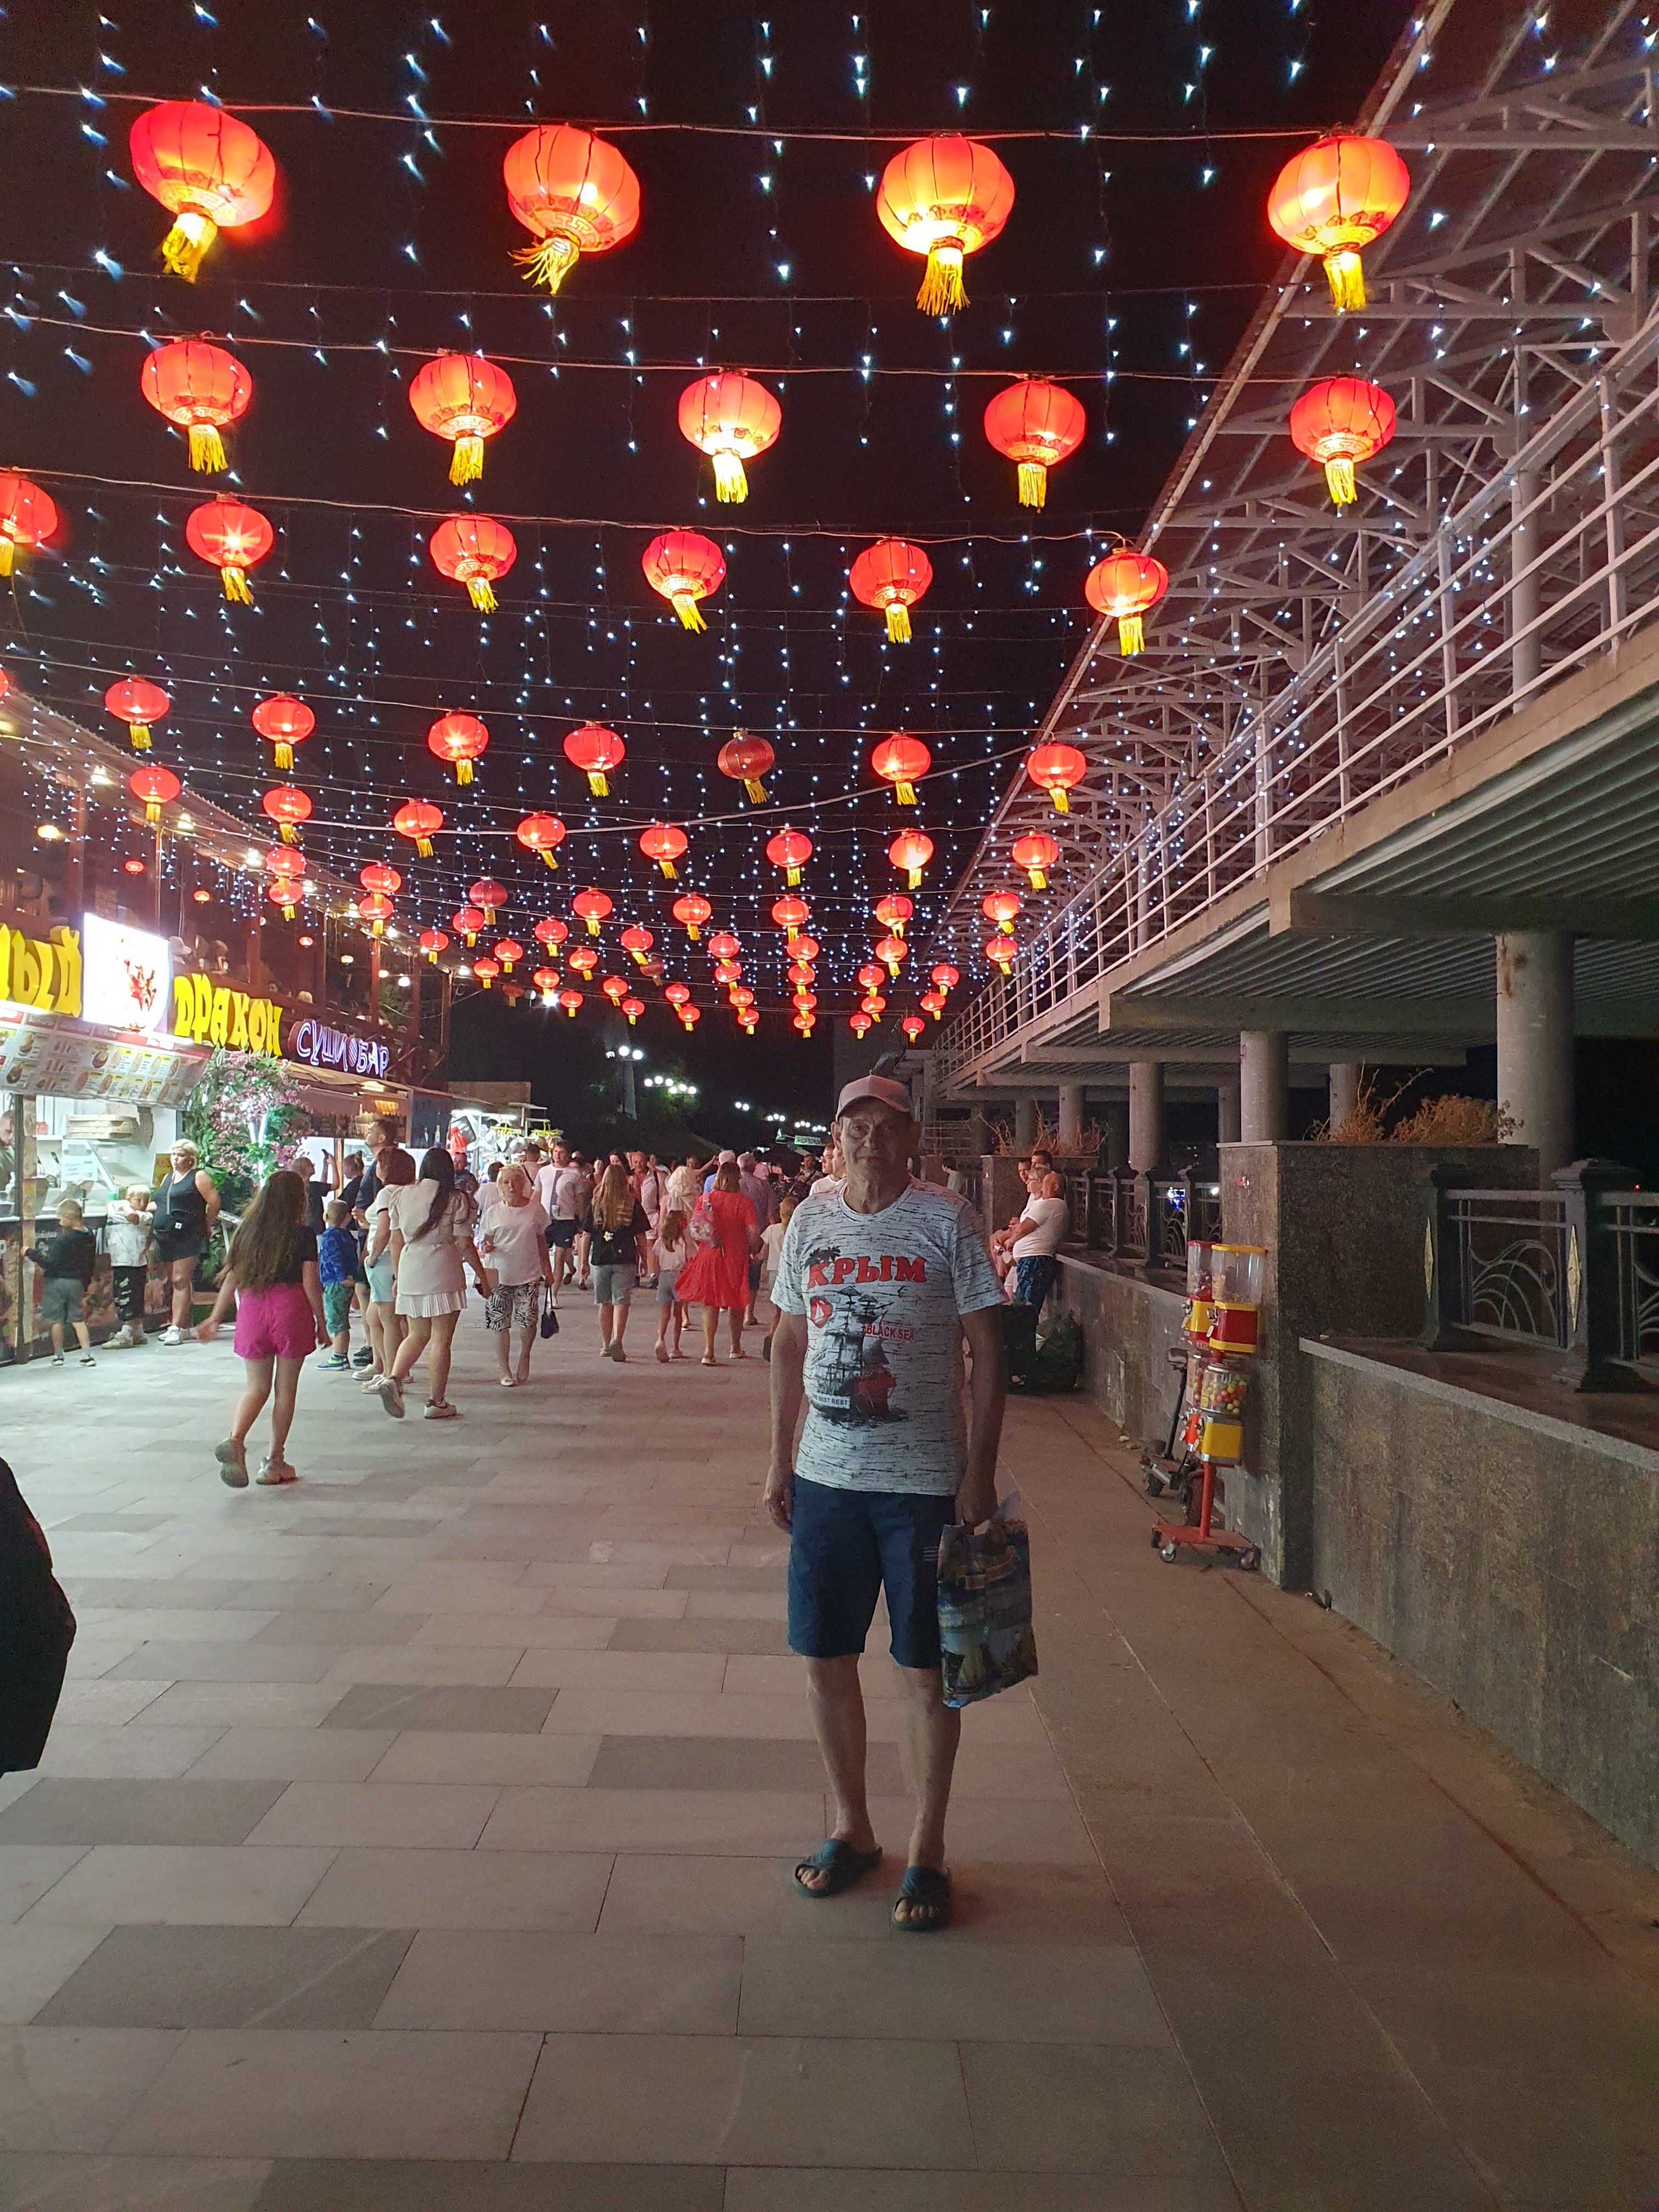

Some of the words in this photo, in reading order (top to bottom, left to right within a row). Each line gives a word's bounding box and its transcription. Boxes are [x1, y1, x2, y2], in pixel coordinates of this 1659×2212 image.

[174, 973, 283, 1057] ДРАКОН
[297, 1019, 348, 1072] СУШИ
[356, 1039, 389, 1078] БАР
[807, 1255, 928, 1289] КРЫМ
[866, 1324, 896, 1338] BLACK
[898, 1328, 914, 1341] SEA
